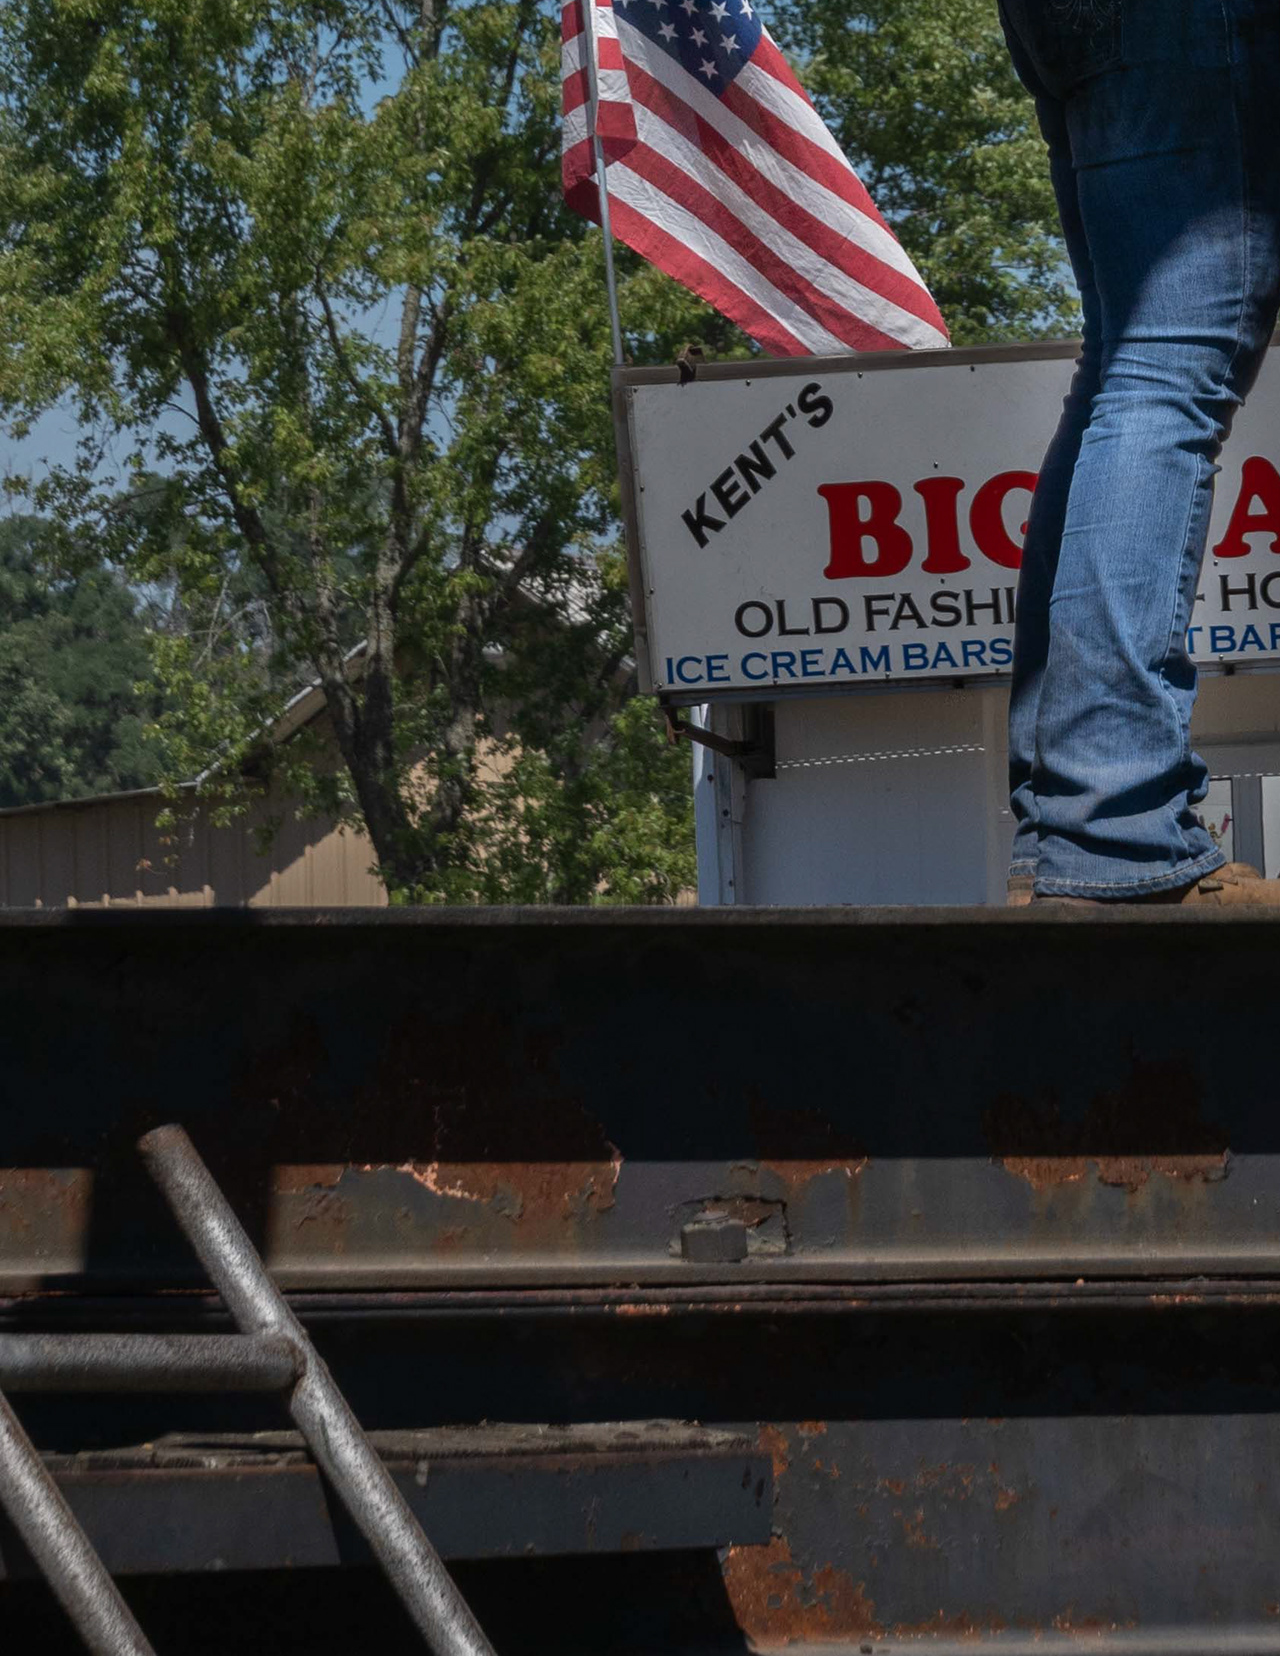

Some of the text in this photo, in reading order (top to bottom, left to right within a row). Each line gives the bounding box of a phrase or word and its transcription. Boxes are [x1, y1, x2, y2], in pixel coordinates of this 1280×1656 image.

[681, 382, 834, 549] KENT'S
[817, 470, 1040, 580] BIG
[735, 595, 850, 638] OLD
[863, 587, 1017, 632] FASHI
[665, 637, 1013, 685] ICE CREAM BARS
